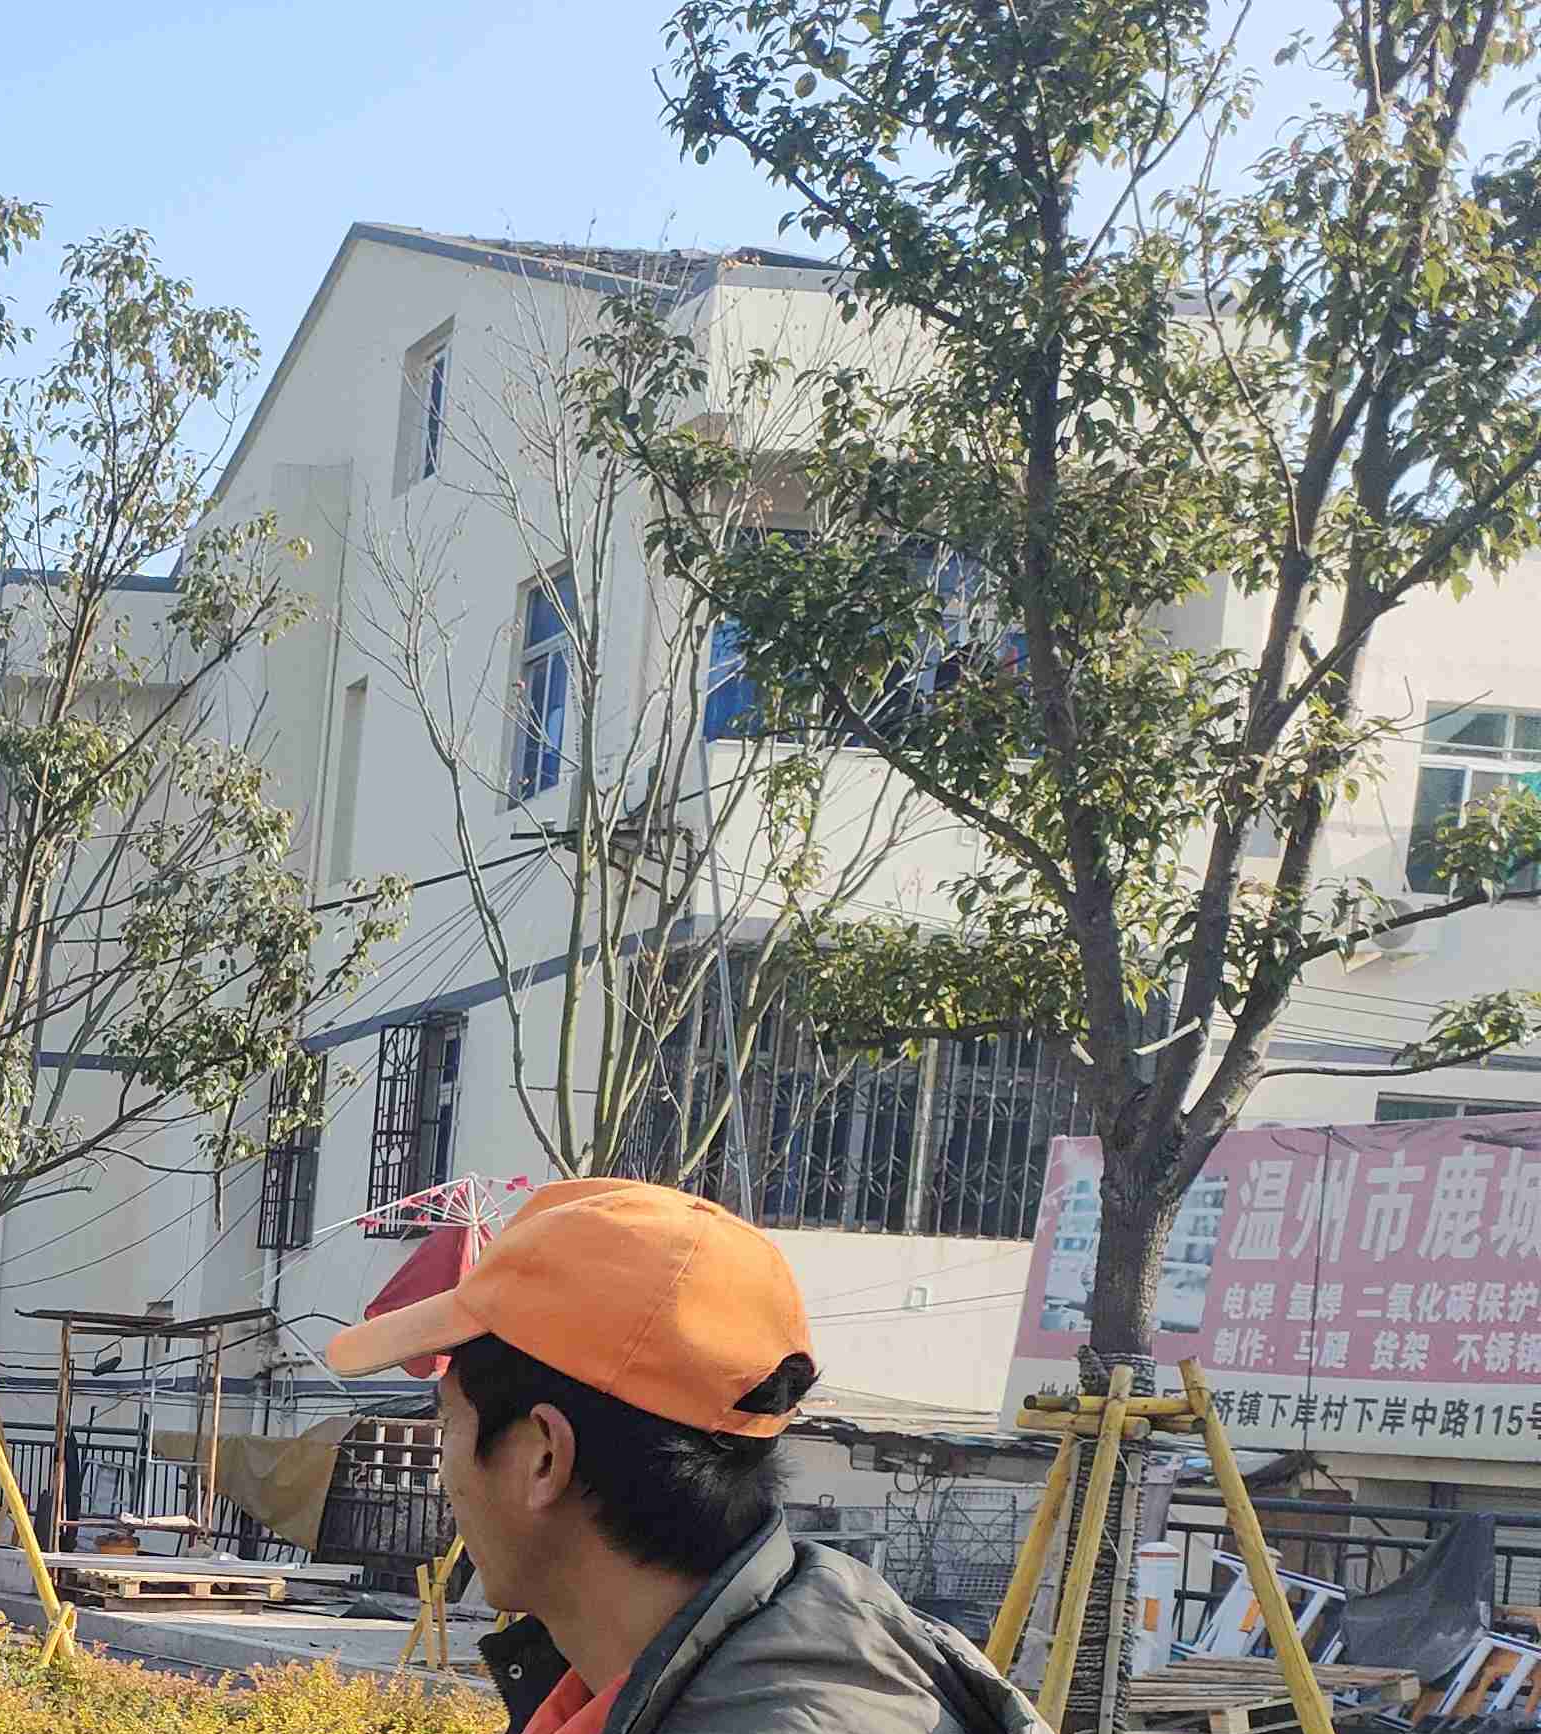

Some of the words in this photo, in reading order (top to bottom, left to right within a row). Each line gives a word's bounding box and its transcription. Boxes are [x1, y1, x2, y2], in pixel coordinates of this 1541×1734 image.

[1228, 1144, 1541, 1263] 温州市鹿城
[1222, 1281, 1276, 1321] 电焊
[1369, 1330, 1430, 1373] 货架
